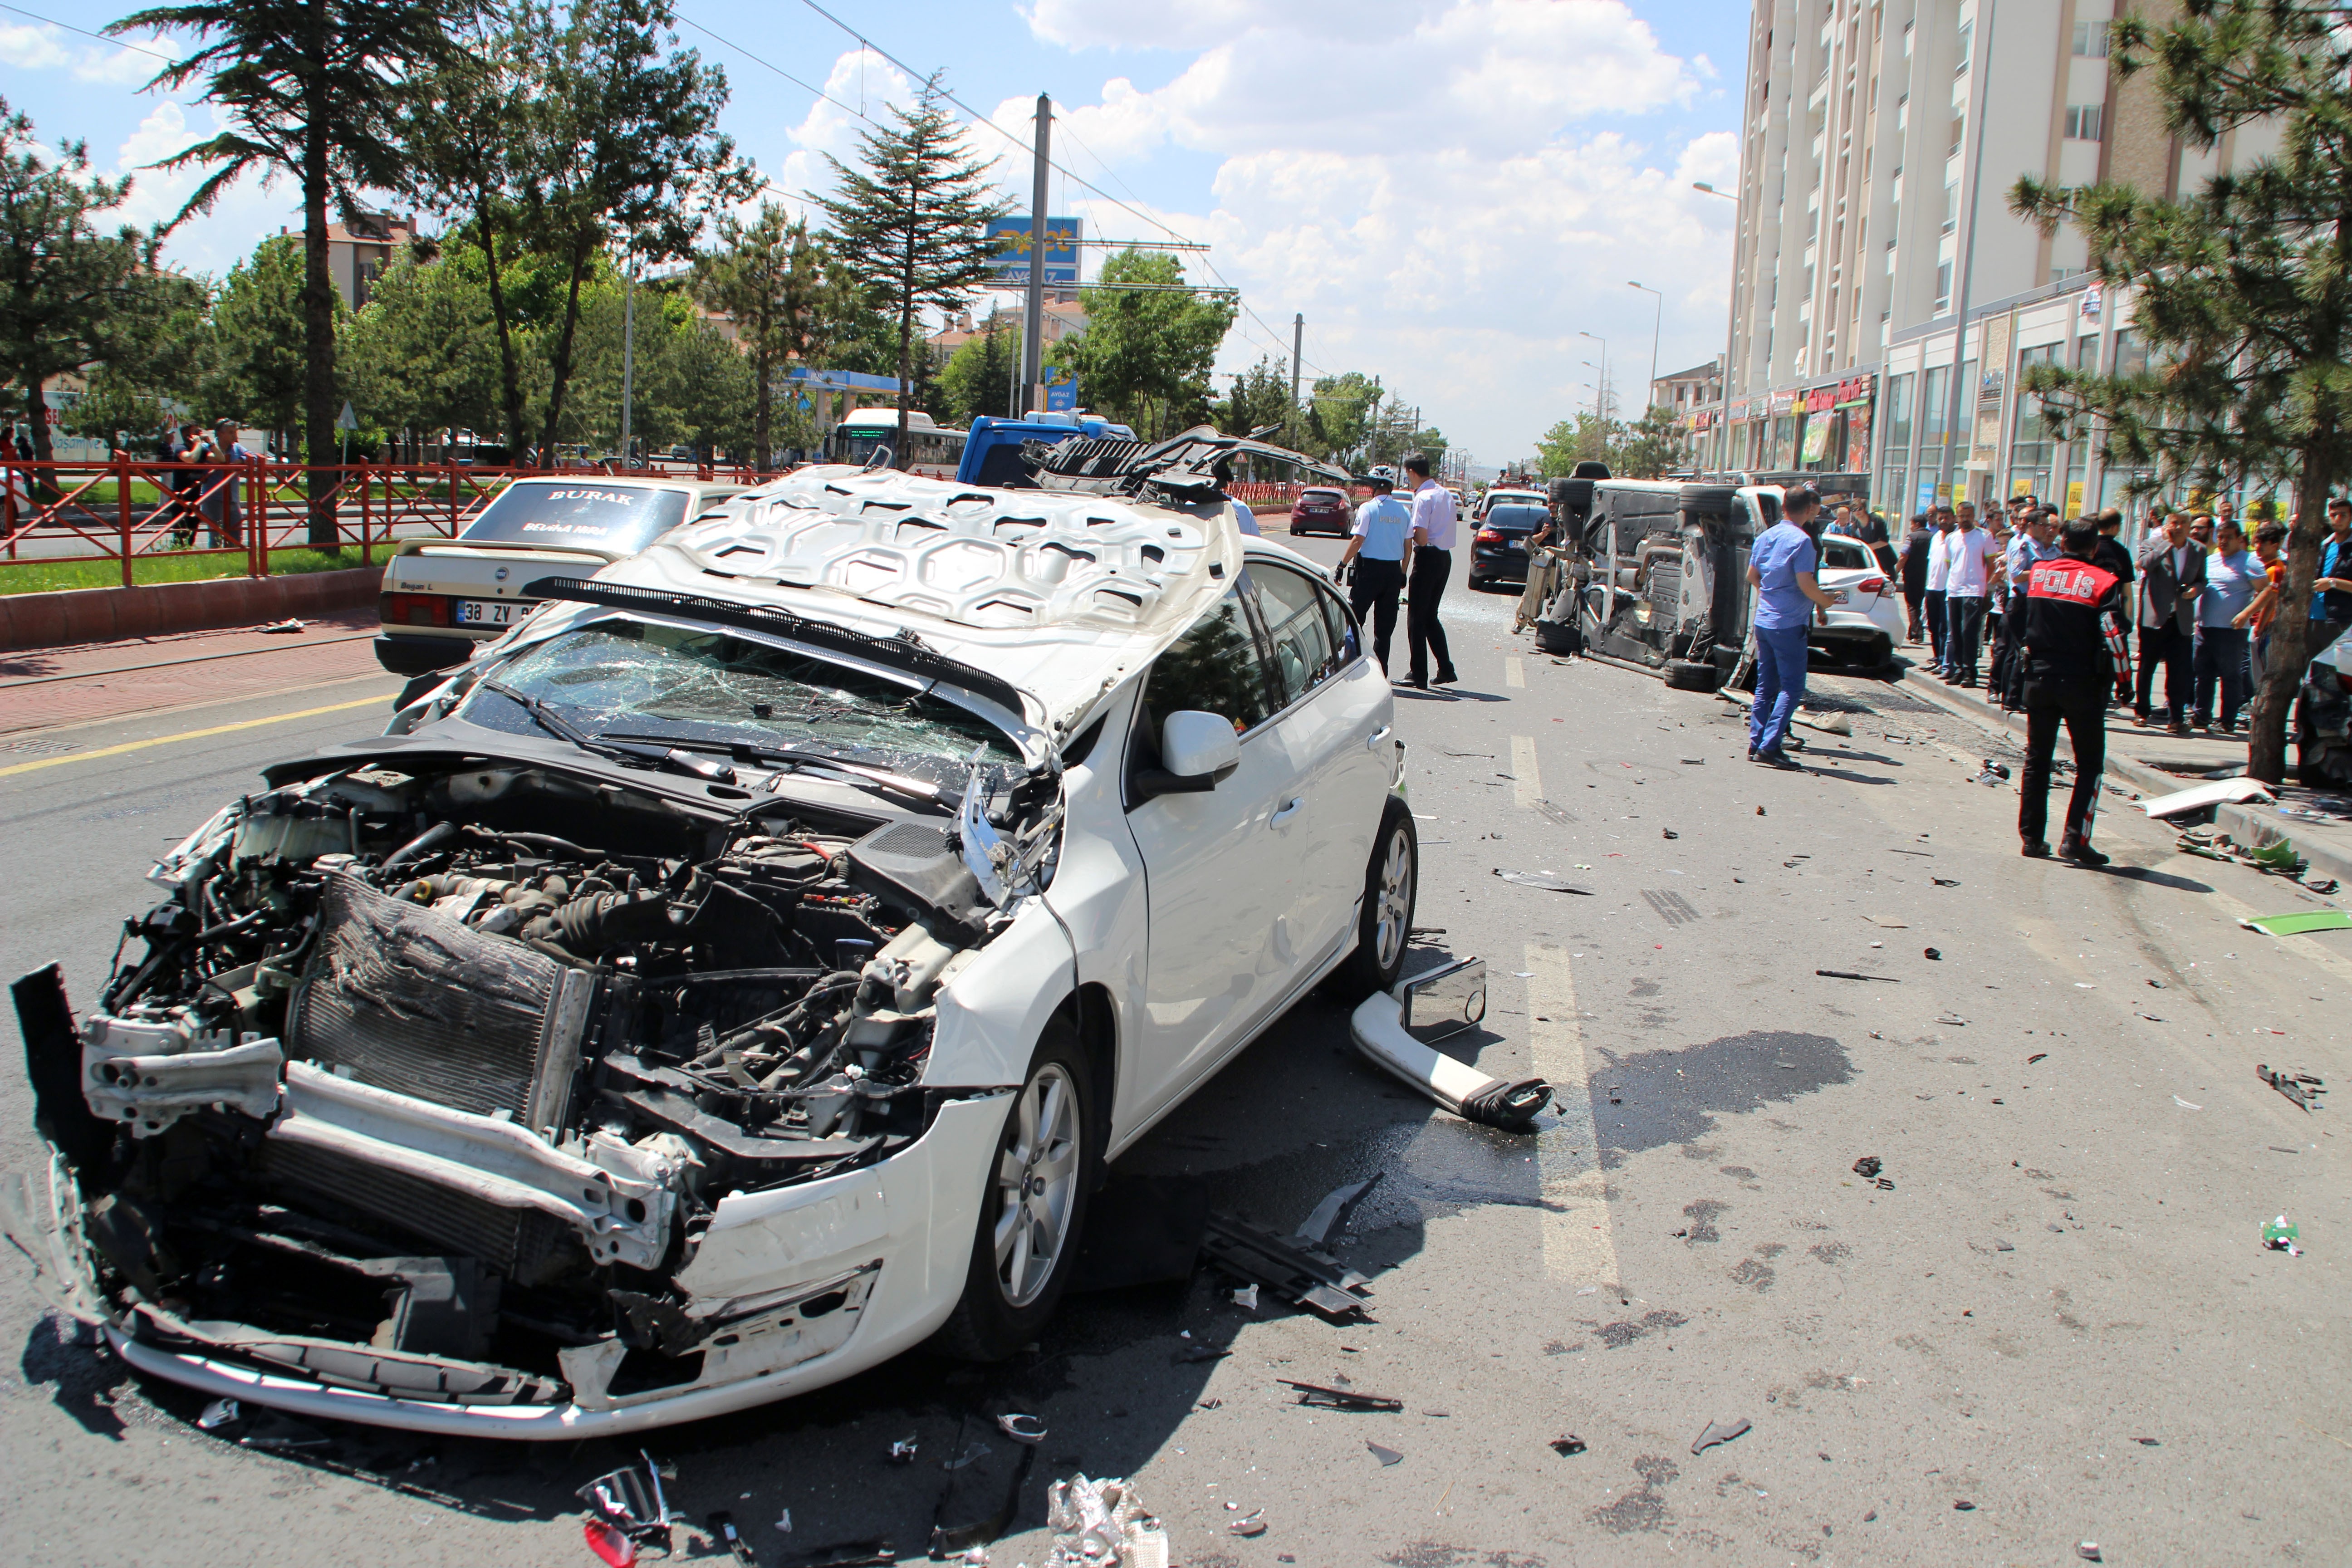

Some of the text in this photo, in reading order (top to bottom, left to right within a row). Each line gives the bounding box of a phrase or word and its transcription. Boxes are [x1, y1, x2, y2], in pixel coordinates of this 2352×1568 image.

[1005, 271, 1057, 284] AYZ
[51, 434, 85, 452] Yaşam
[548, 490, 634, 506] BURAK
[2031, 569, 2095, 598] POLİS
[466, 604, 534, 622] 38 ZV 9
